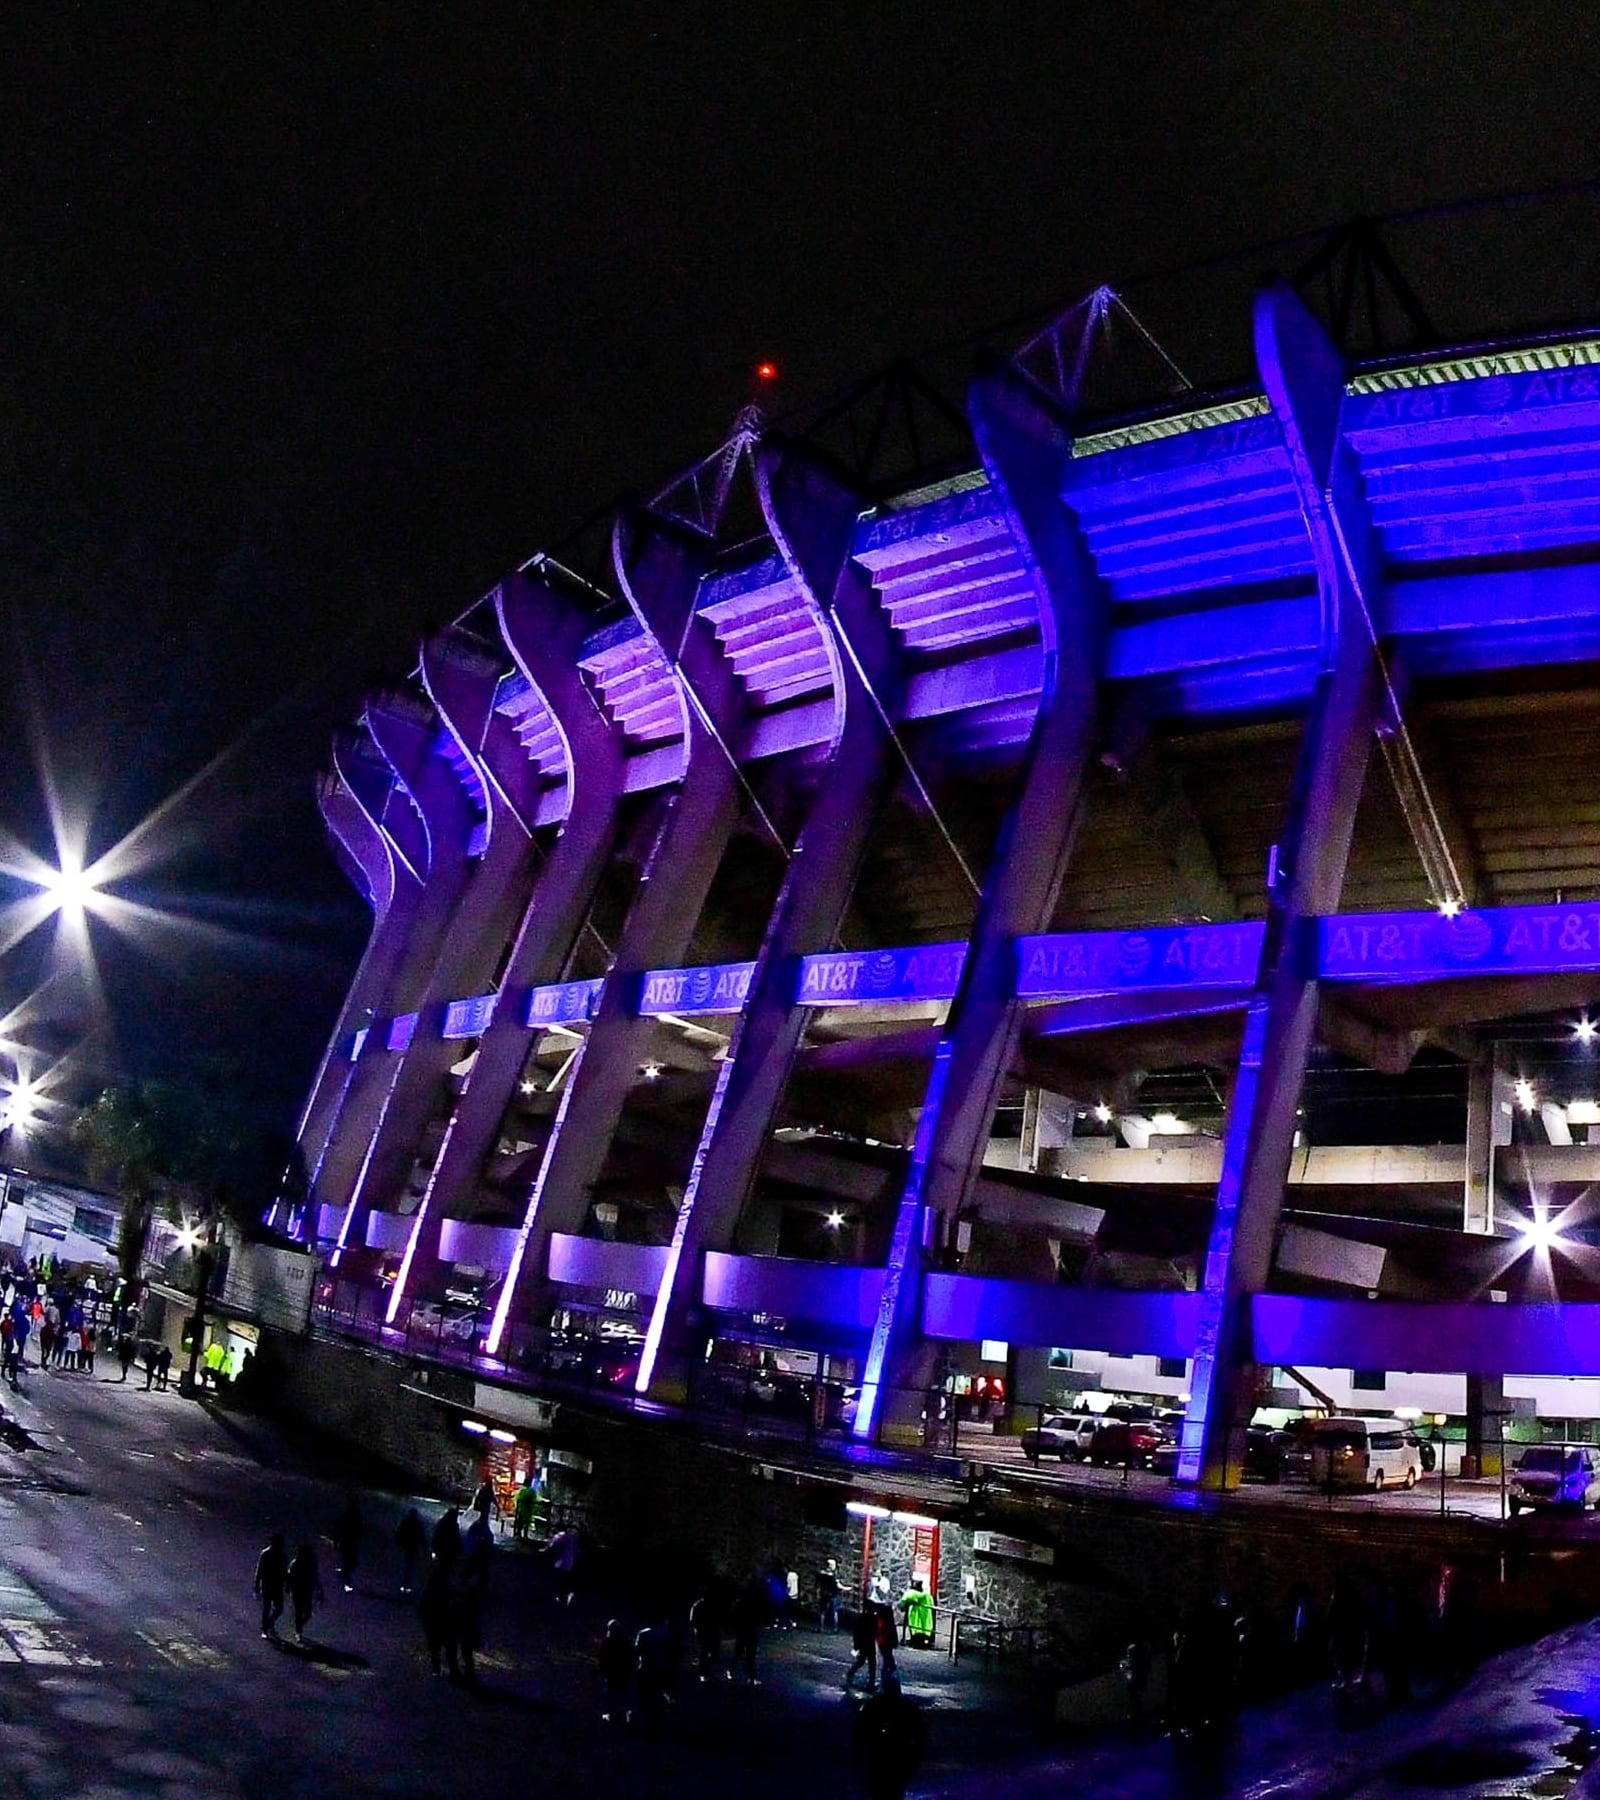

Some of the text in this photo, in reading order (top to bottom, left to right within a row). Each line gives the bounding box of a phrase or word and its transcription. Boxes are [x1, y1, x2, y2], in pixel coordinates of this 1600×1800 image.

[1363, 386, 1462, 425] AT&T
[1165, 931, 1254, 973] AT&T
[1326, 922, 1431, 964] AT&T
[642, 969, 751, 1004] AT&T AT&
[803, 960, 866, 992] AT&T
